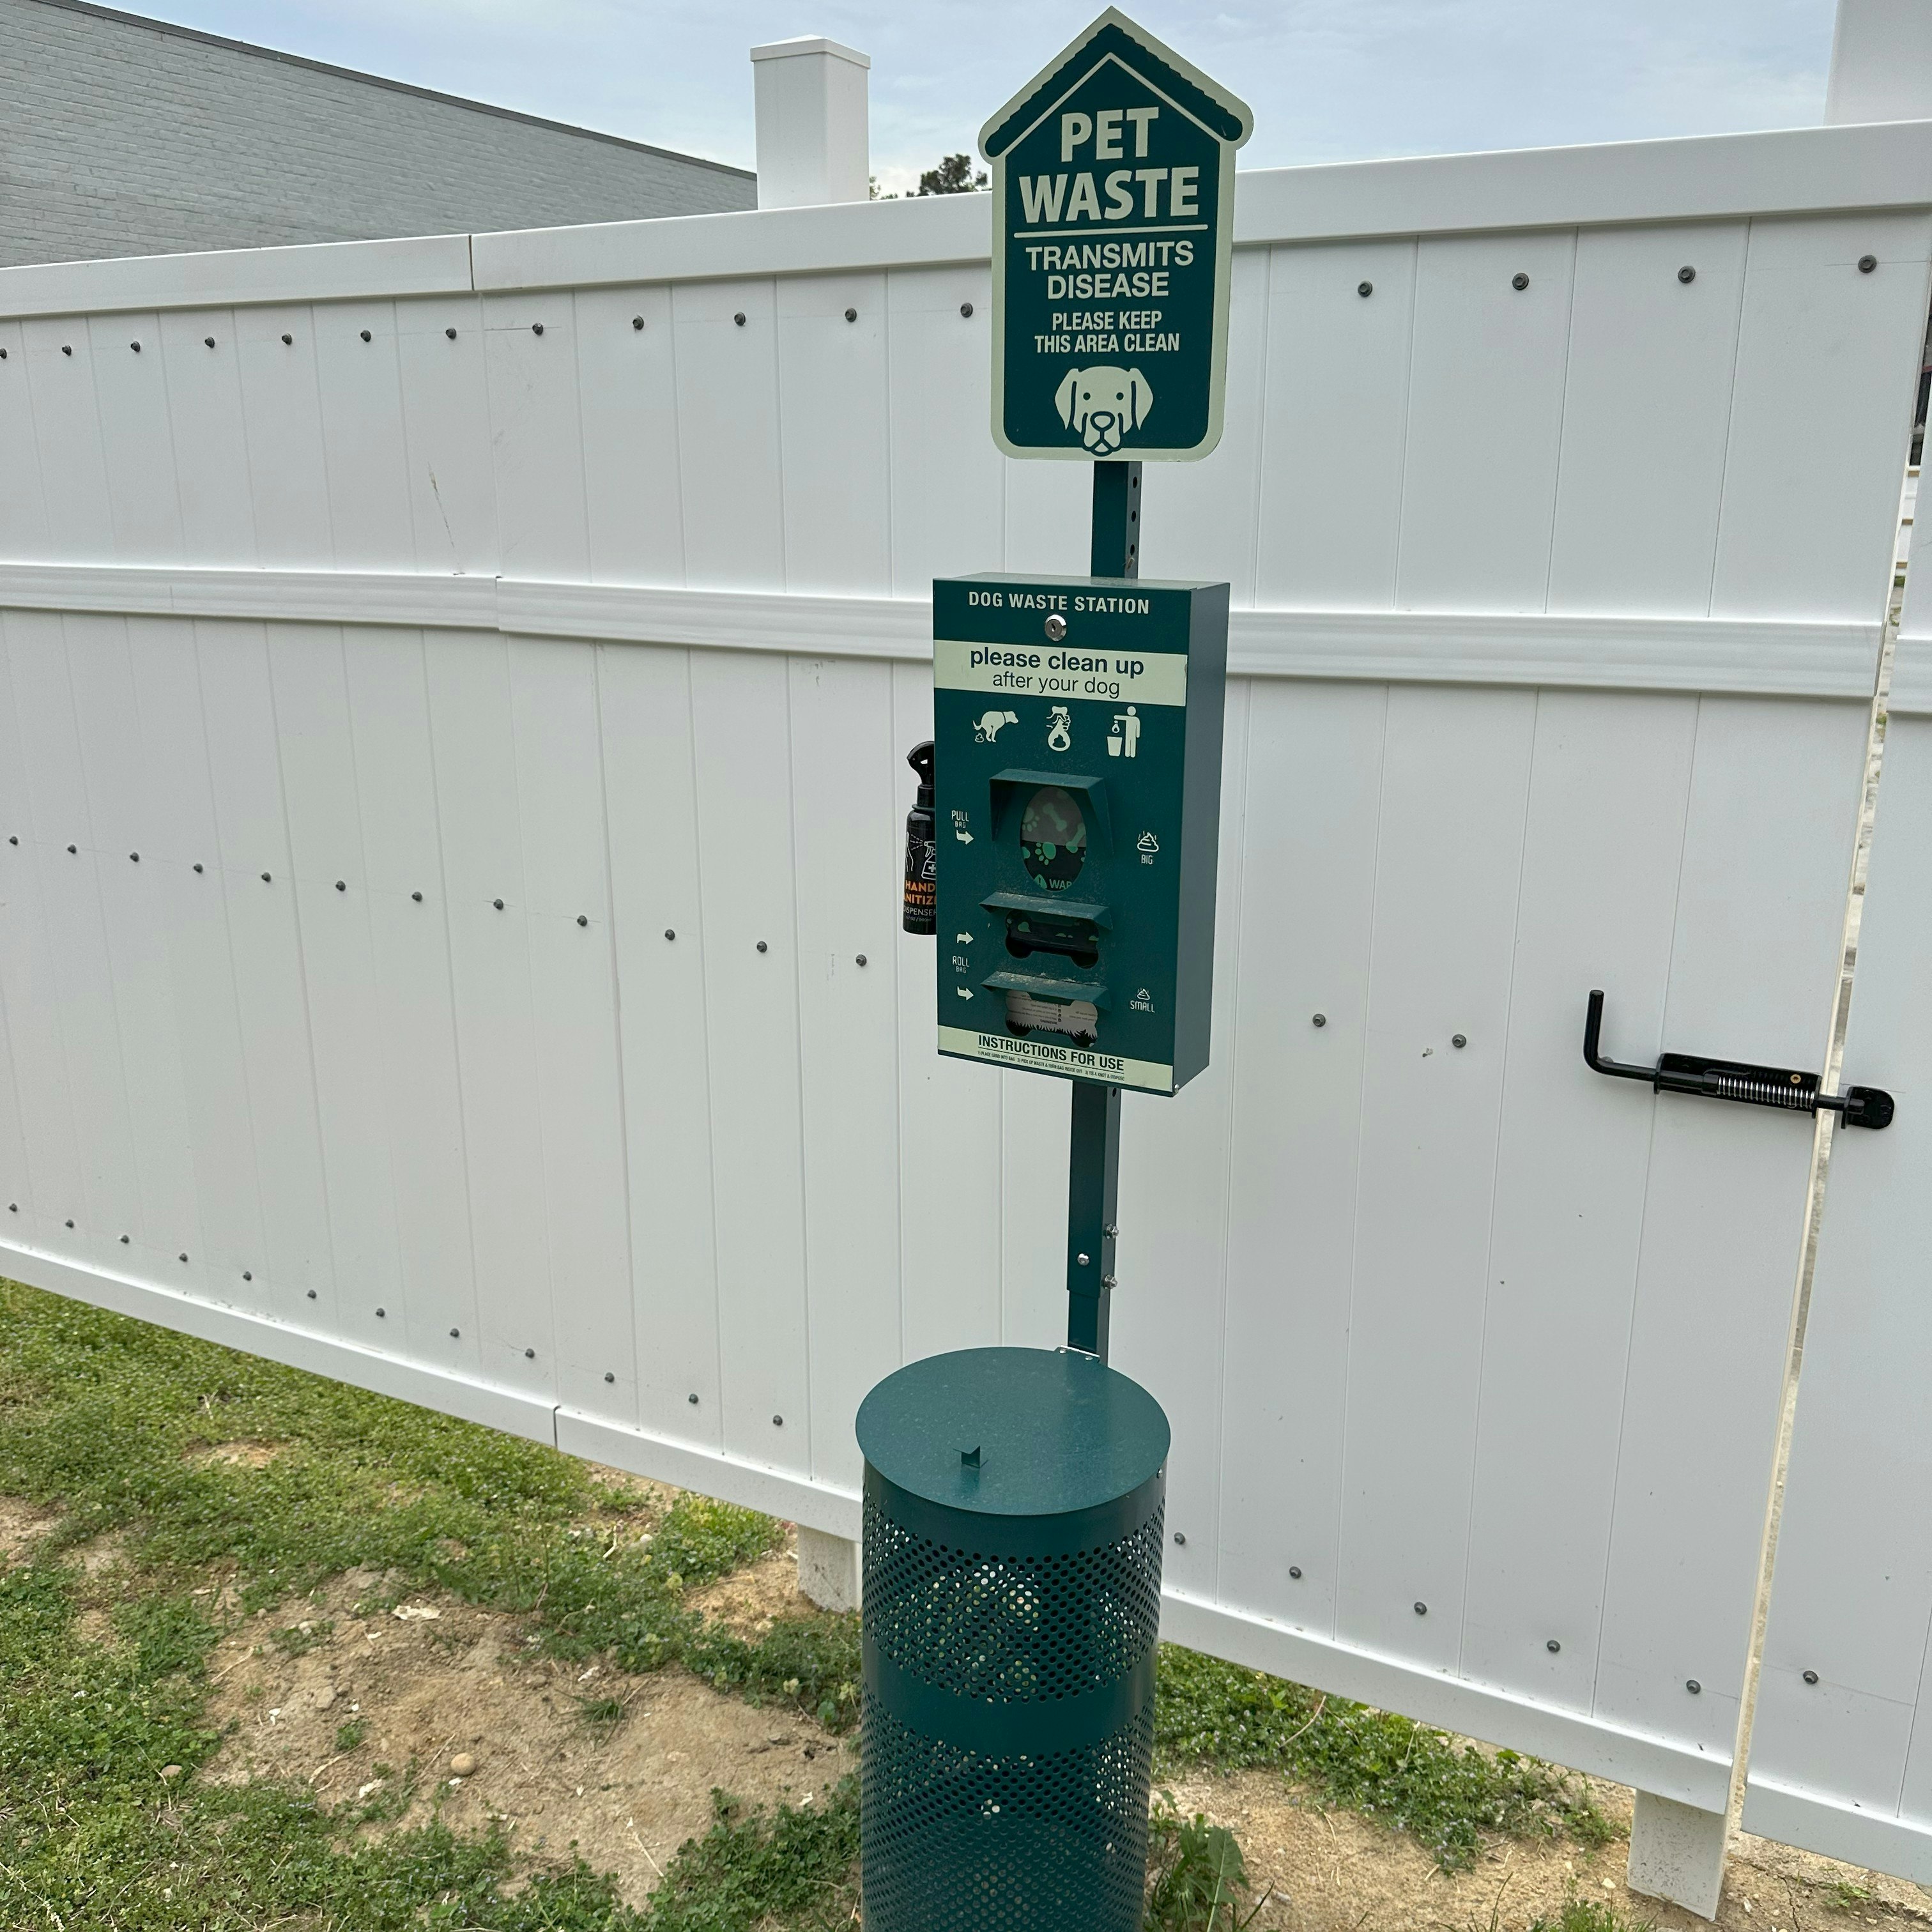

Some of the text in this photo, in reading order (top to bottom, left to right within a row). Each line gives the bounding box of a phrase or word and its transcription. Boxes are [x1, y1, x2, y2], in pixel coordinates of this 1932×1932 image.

[1061, 107, 1159, 162] PET
[1019, 166, 1199, 224] WASTE
[1026, 241, 1193, 271] TRANSMITS
[1048, 272, 1169, 300] DISEASE
[1052, 310, 1162, 330] PLEASE KEEP
[1034, 333, 1179, 353] THIS AREA CLEAN
[969, 592, 1149, 614] DOG WASTE STATION
[970, 647, 1144, 678] please clean up
[993, 671, 1120, 699] after your dog
[952, 810, 969, 822] PULL
[1141, 854, 1153, 864] BIG
[905, 880, 935, 892] HAND
[953, 956, 969, 967] ROLL
[1130, 1000, 1155, 1013] SMALL
[979, 1035, 1124, 1071] INSTRUCTIONS FOR USE
